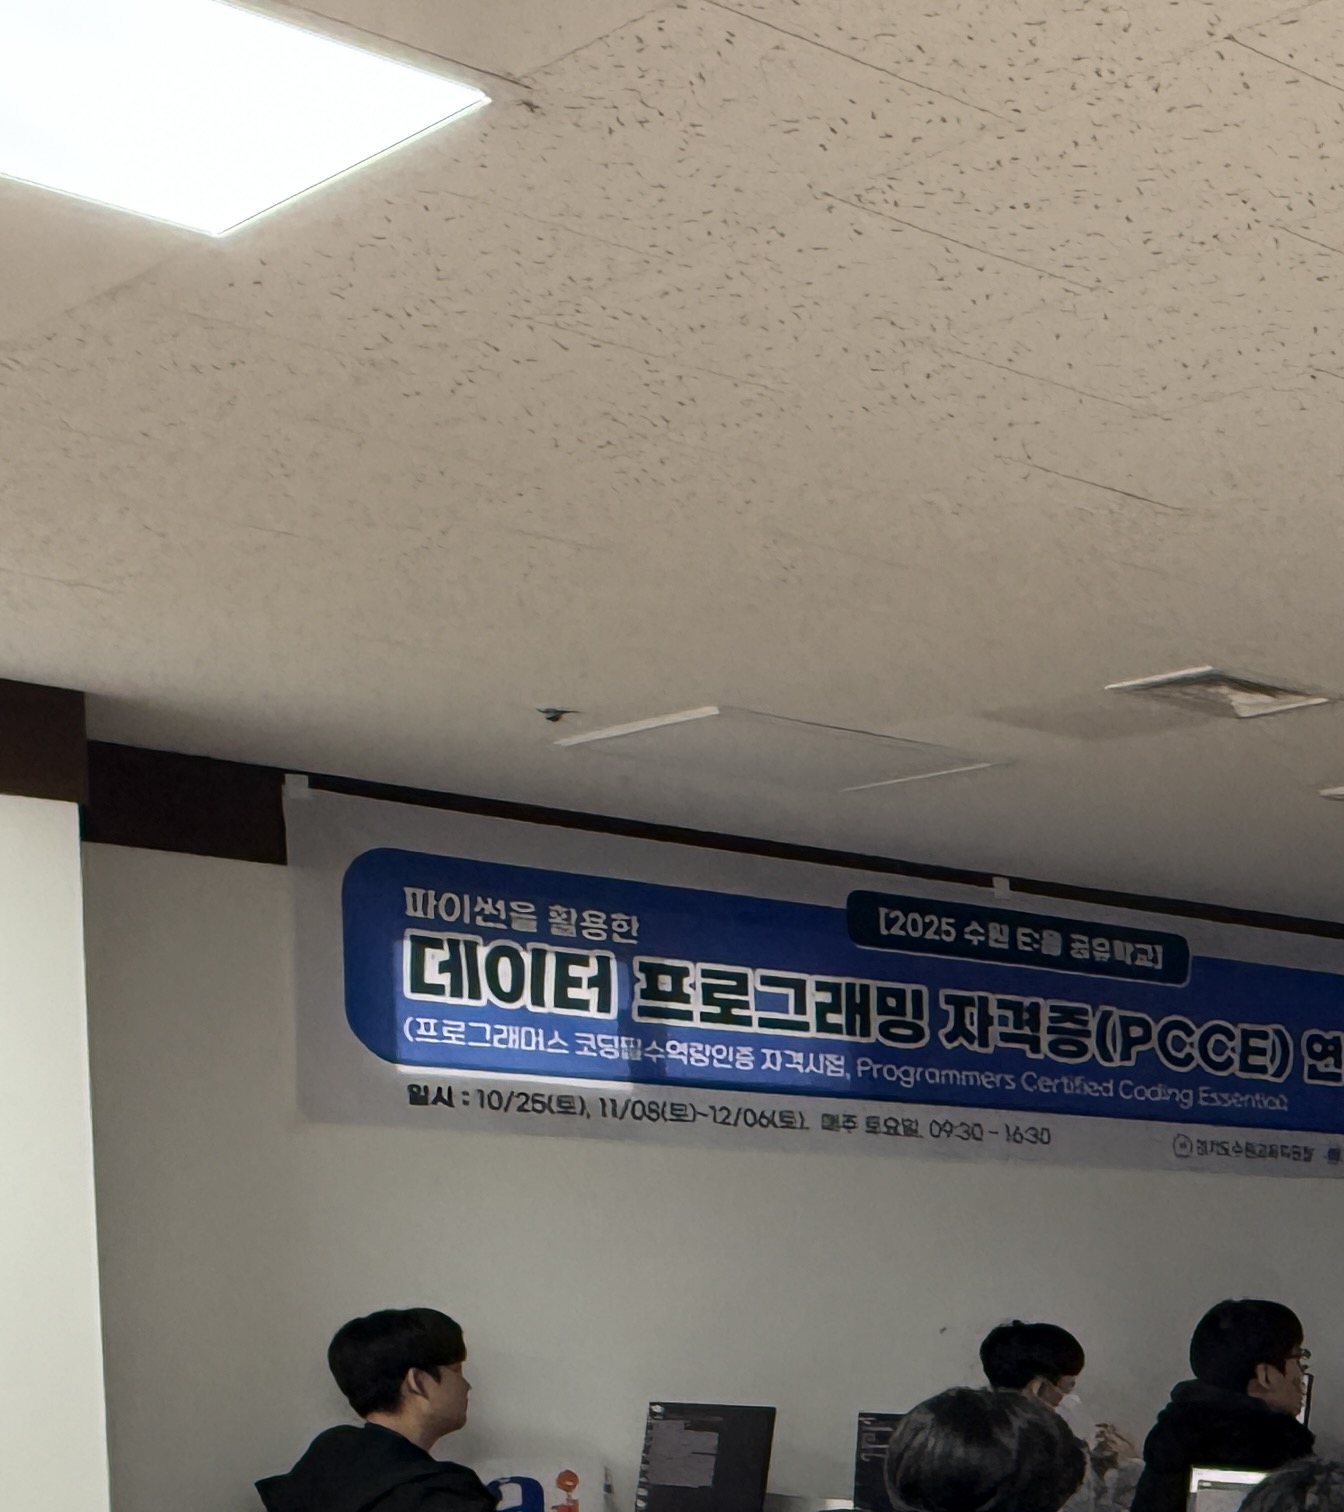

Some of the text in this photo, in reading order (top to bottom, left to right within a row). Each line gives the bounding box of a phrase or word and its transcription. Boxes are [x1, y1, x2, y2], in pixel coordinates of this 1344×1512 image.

[403, 886, 640, 944] 파이썬을 활용한
[402, 928, 619, 1020] 데이터
[632, 956, 929, 1049] 프로그래밍
[938, 987, 1294, 1083] 자격증(PCCE)
[403, 1016, 570, 1055] (프로그래머스
[575, 1032, 754, 1071] 코딩필수역량인증
[856, 1058, 1017, 1091] Programmers
[1020, 1071, 1115, 1098] Certified
[1118, 1079, 1193, 1110] Coding
[407, 1083, 456, 1108] 일시
